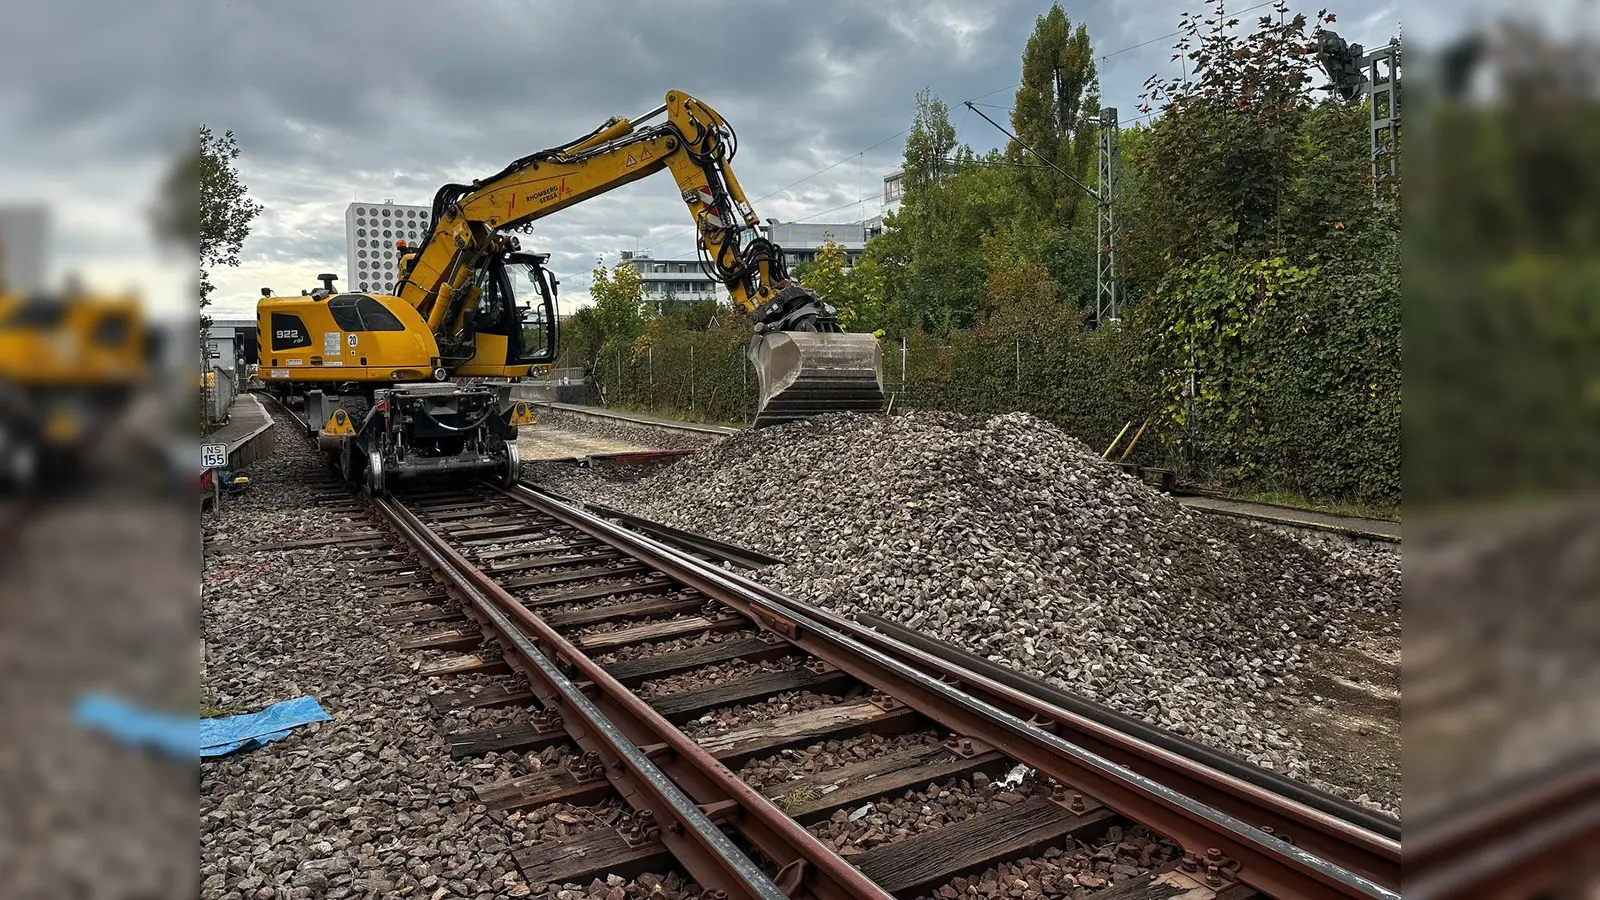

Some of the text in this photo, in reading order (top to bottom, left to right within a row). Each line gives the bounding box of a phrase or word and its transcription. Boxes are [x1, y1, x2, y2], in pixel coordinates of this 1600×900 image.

[525, 185, 558, 201] RHOMBERG
[539, 193, 558, 203] SERSA
[276, 329, 298, 338] 922
[349, 335, 356, 345] 20
[207, 446, 221, 454] NS
[204, 454, 224, 465] 155
